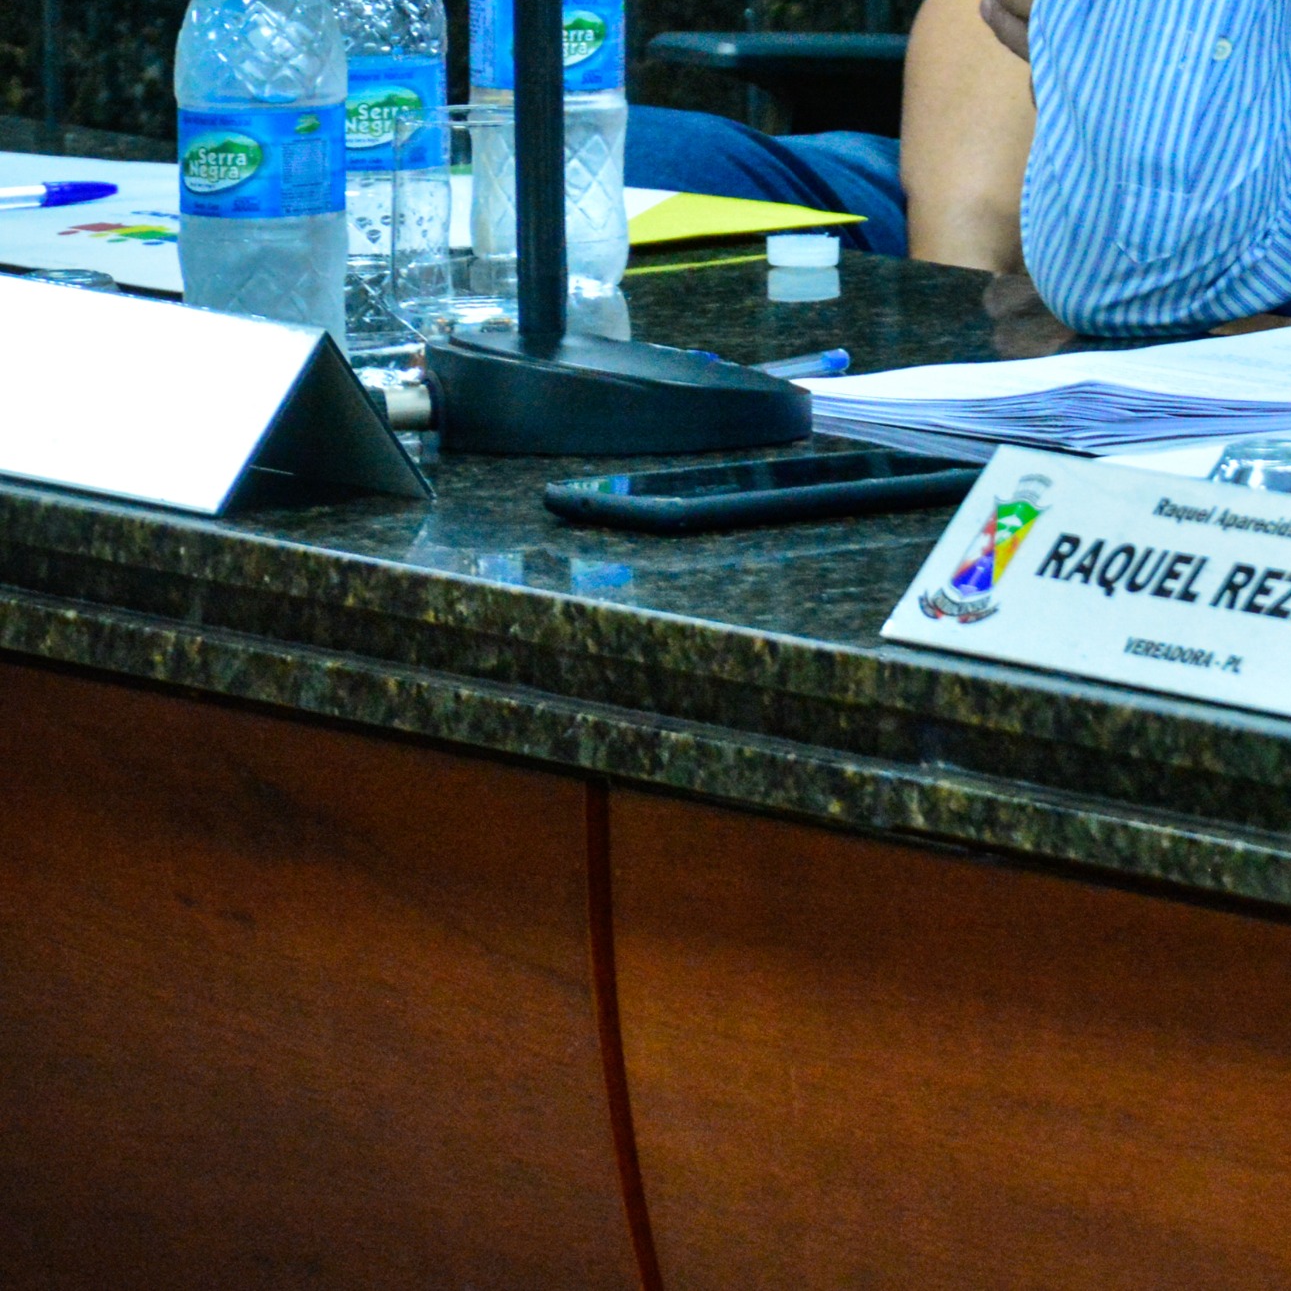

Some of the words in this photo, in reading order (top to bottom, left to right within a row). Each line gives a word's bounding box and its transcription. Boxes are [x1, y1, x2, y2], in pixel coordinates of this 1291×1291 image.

[563, 28, 595, 42] erra
[345, 117, 392, 138] Negr
[198, 147, 248, 166] Serra
[188, 161, 241, 183] Negra
[1152, 496, 1218, 525] Raquel
[1034, 532, 1210, 604] RAQUEL
[1123, 636, 1214, 667] VEREADORA
[1221, 653, 1244, 674] PL
